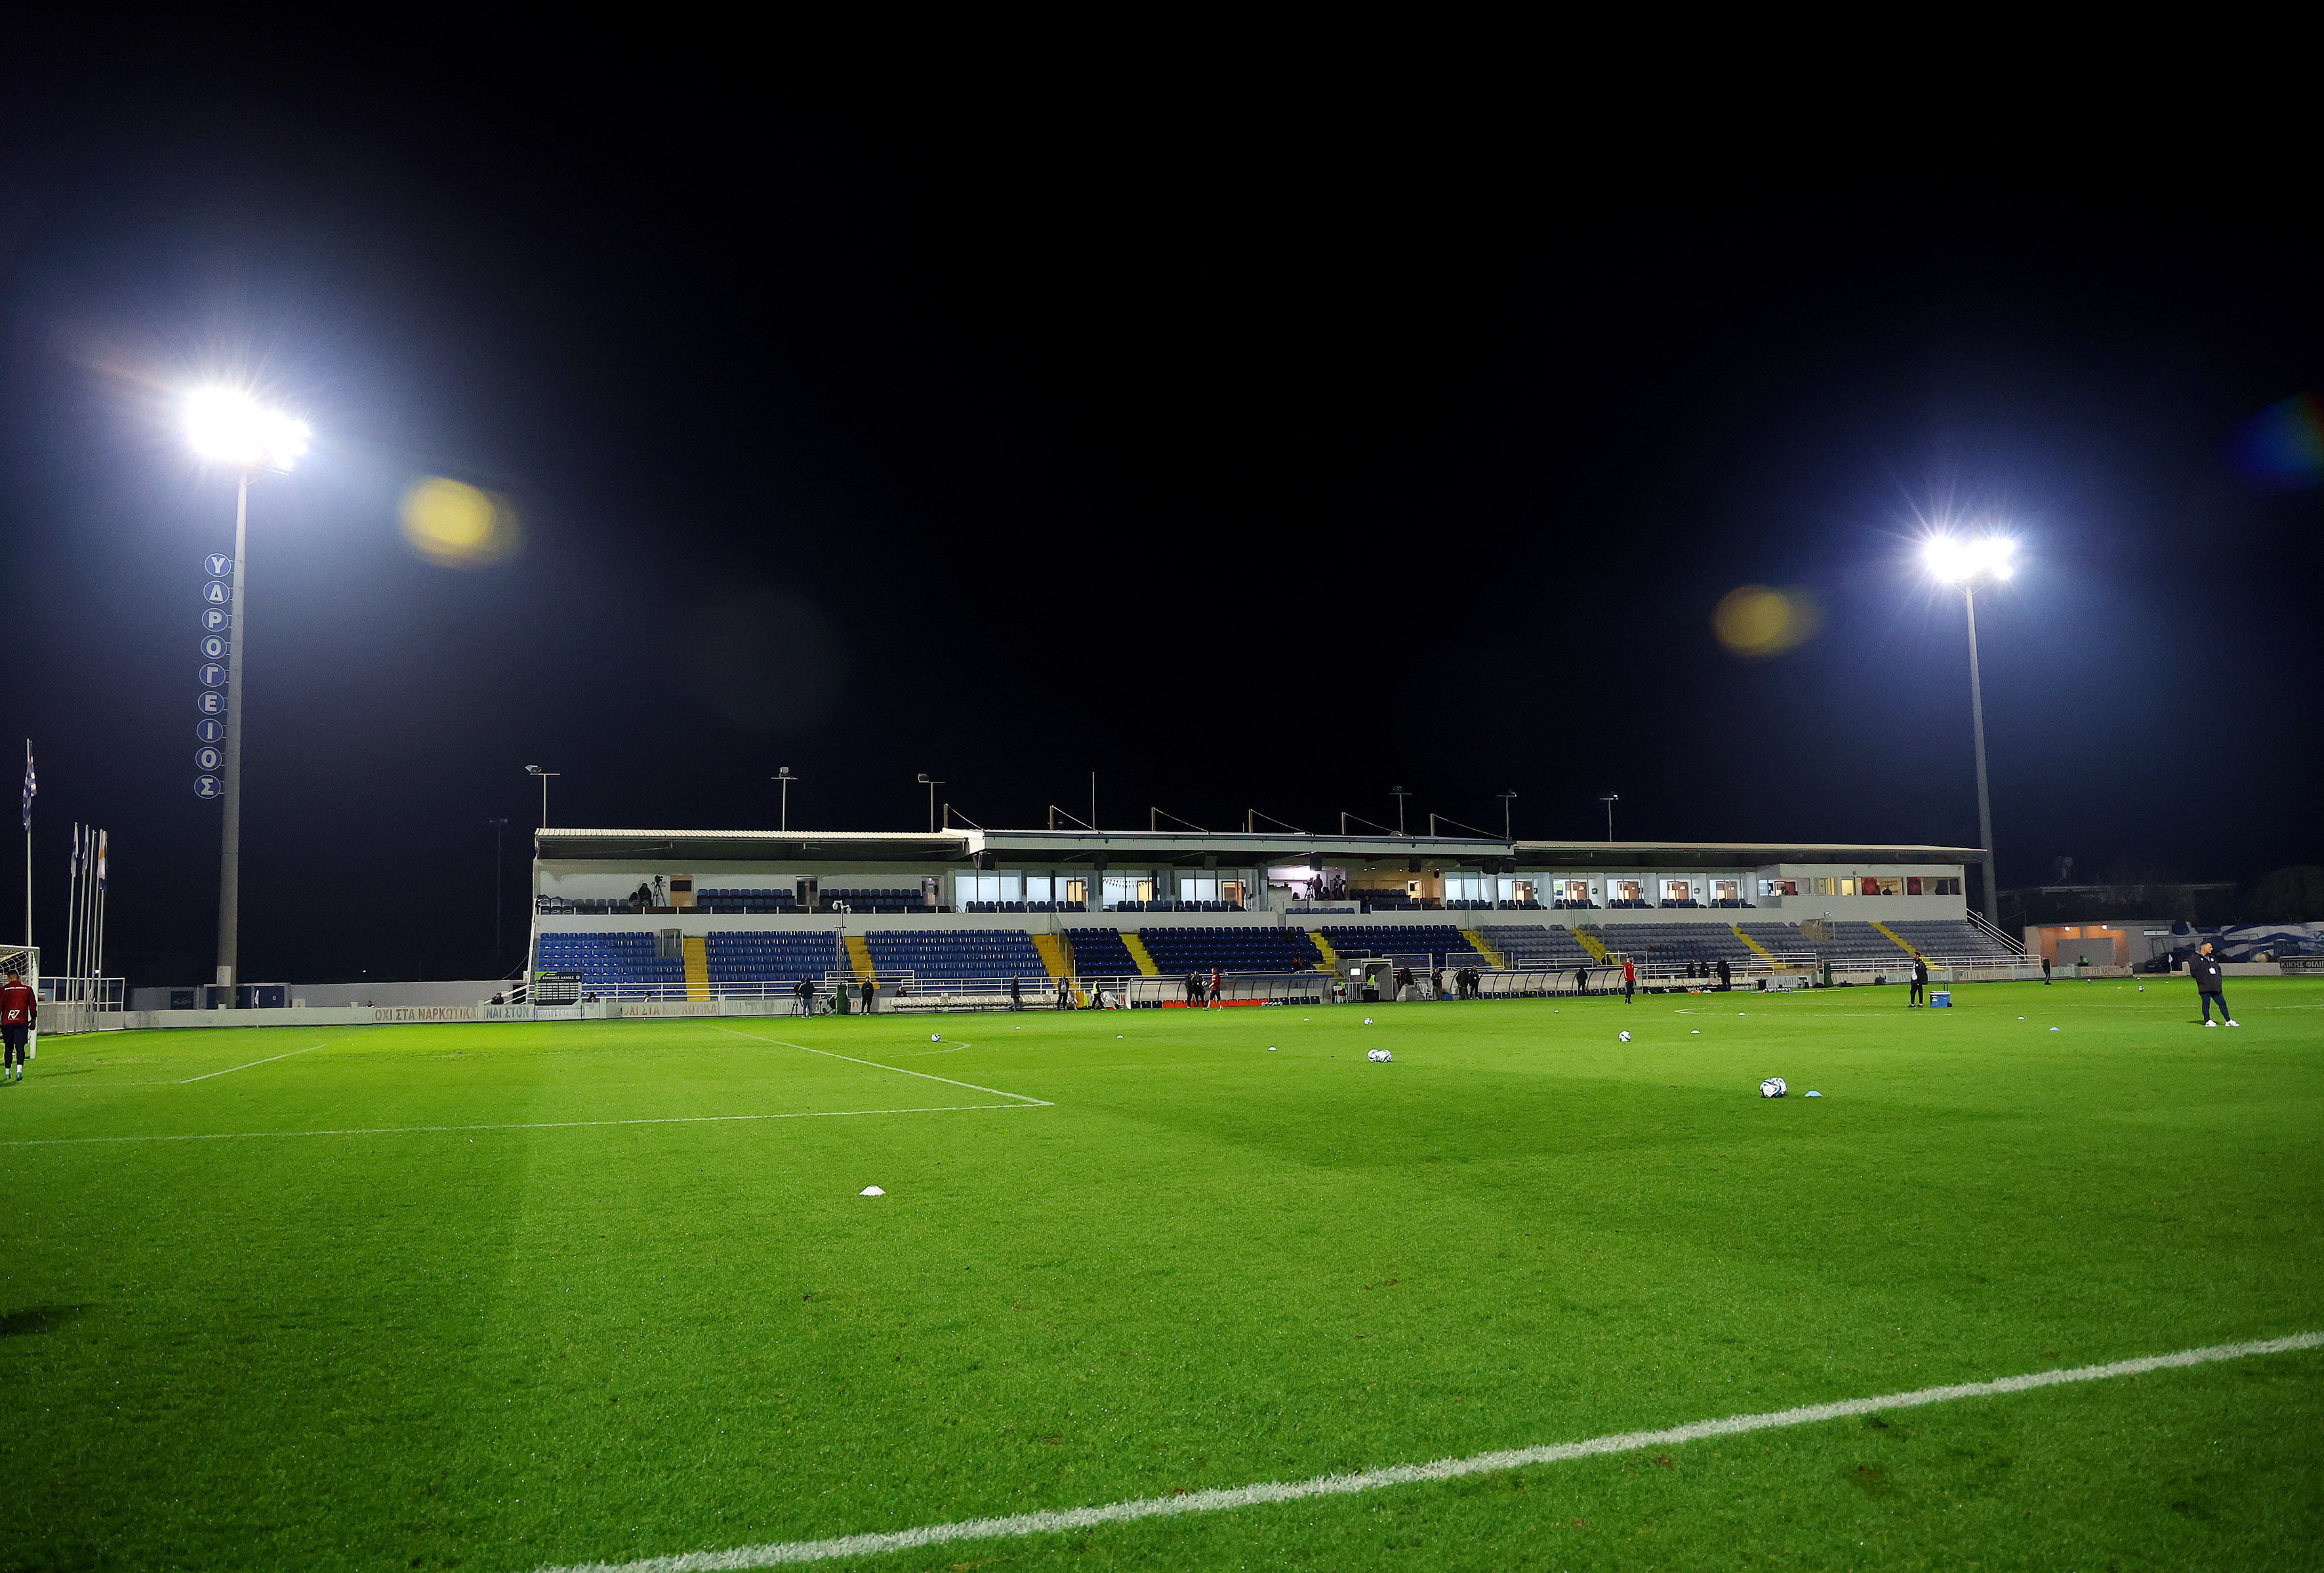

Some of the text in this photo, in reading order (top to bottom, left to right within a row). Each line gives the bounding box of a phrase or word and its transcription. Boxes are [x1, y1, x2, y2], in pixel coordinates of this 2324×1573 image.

[200, 556, 227, 796] ΥΔΡΟΓΕΙΟΣ
[375, 1007, 478, 1021] ΟΧΙ ΣΤΑ ΝΑΡΚΩΤΙΚΑ
[486, 1008, 501, 1019] ΝΑΙ
[504, 1006, 529, 1019] ΣΤΟΝ
